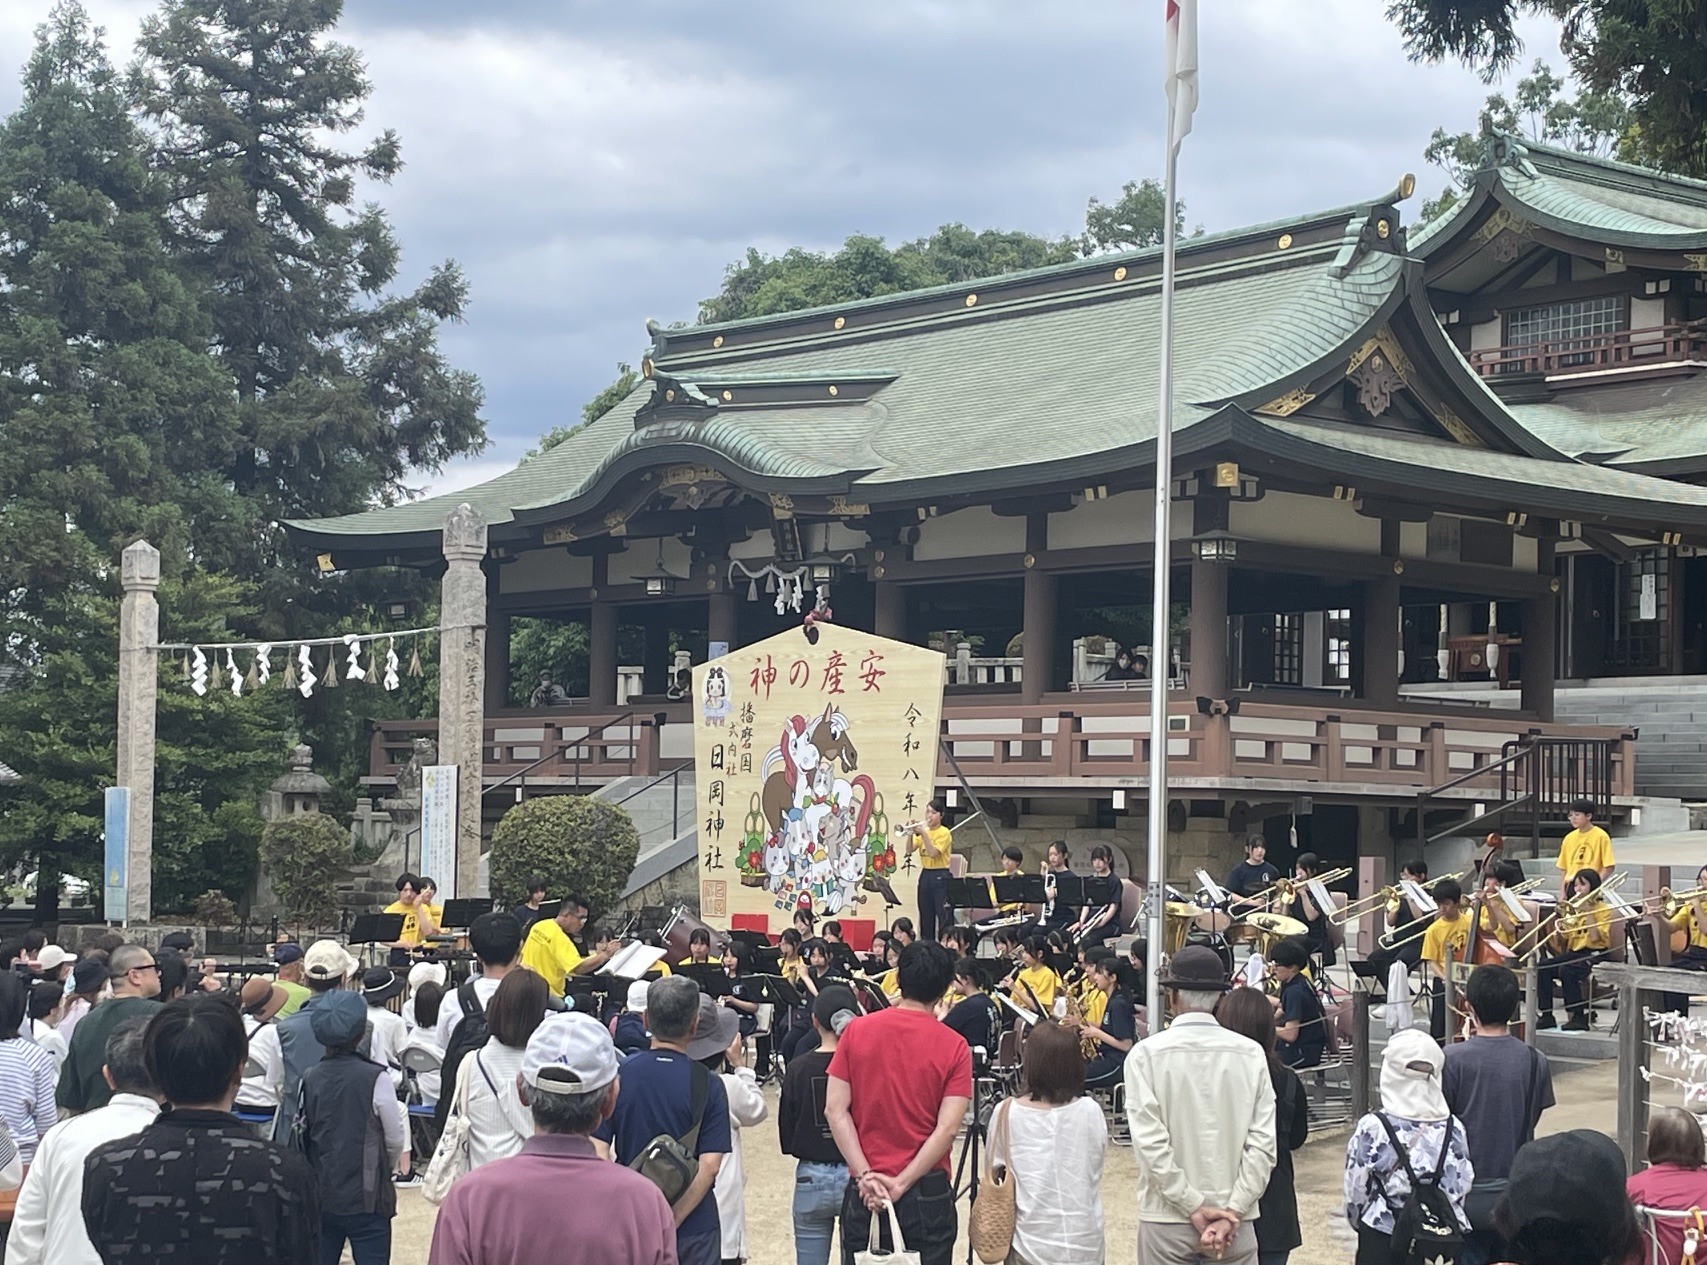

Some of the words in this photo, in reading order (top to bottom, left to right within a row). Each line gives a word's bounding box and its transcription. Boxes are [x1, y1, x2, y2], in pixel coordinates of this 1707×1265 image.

[750, 649, 886, 701] 安産の神
[726, 721, 739, 778] 式内社
[740, 701, 756, 773] 播磨国
[704, 743, 725, 873] 日岡神社
[901, 702, 922, 878] 令和八年年
